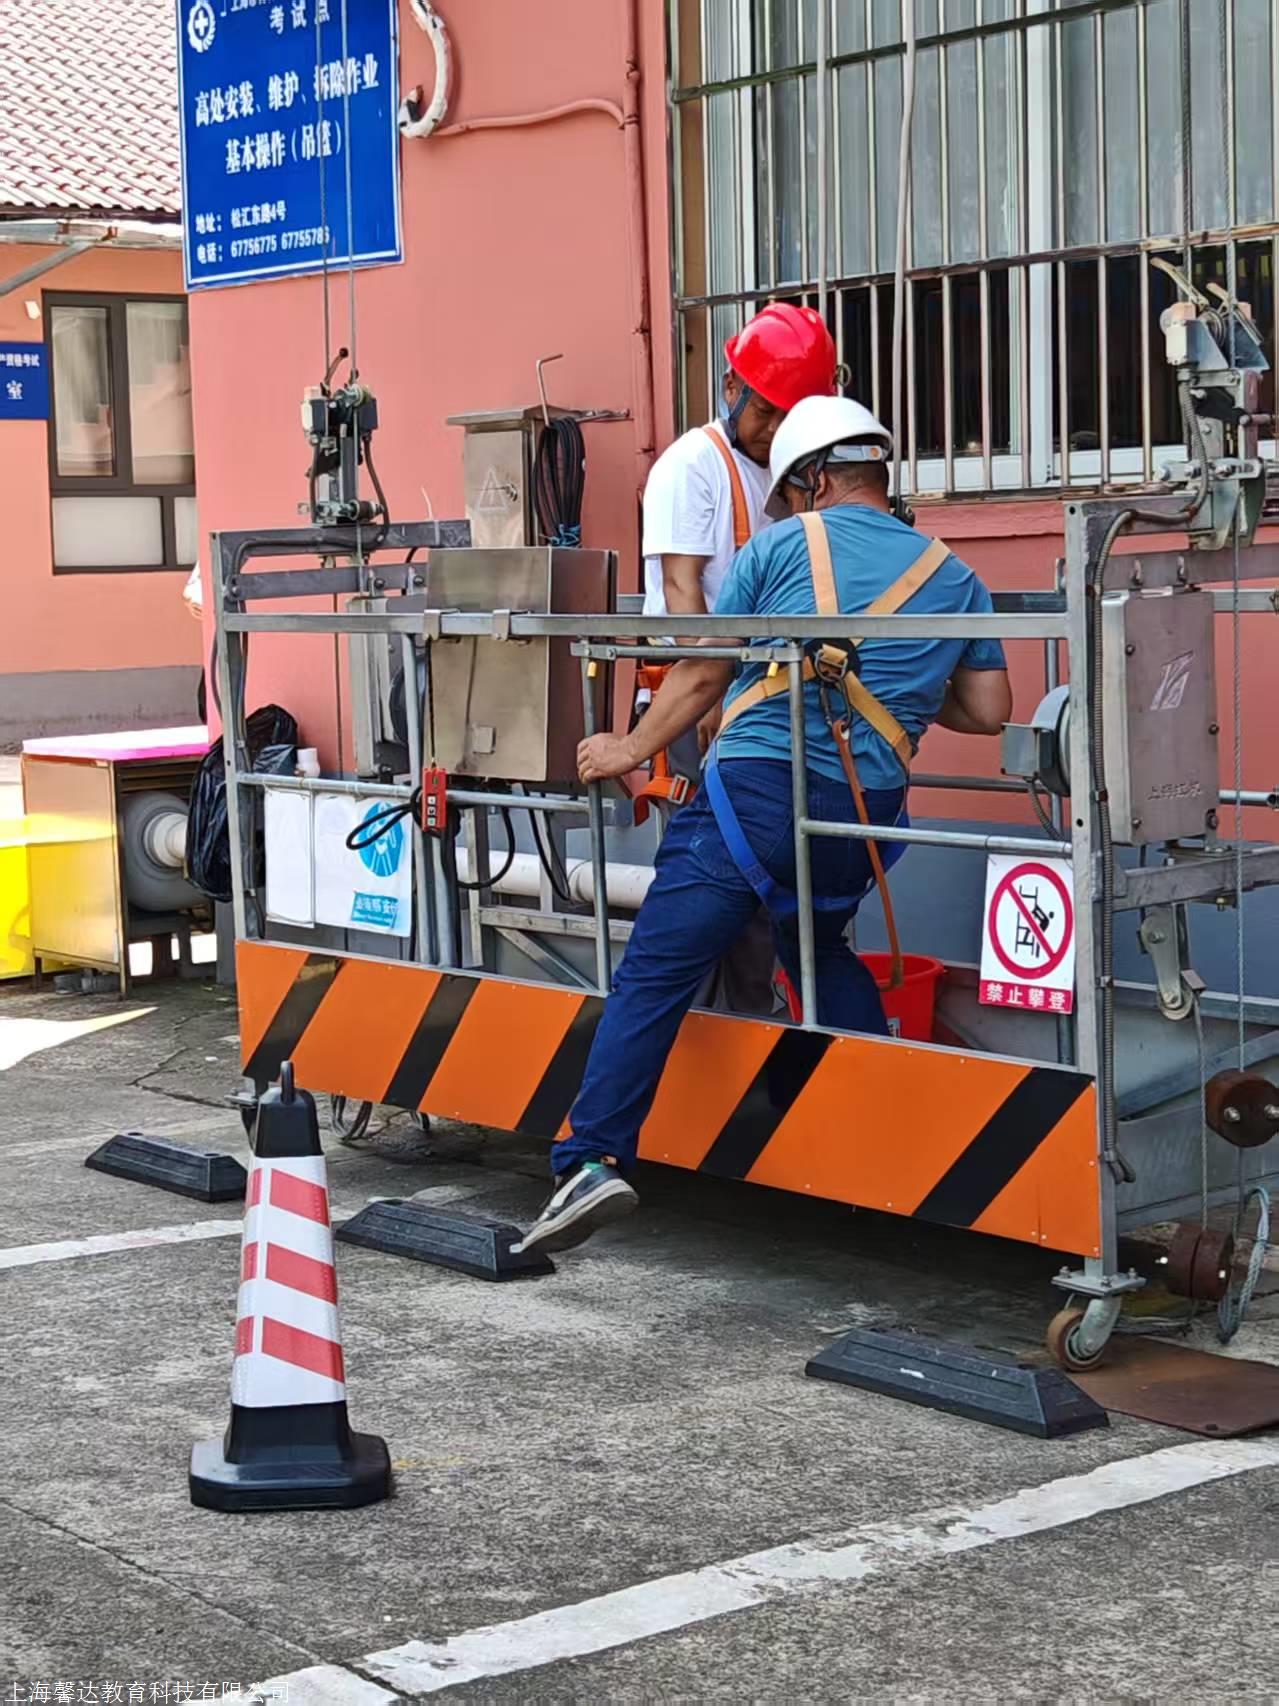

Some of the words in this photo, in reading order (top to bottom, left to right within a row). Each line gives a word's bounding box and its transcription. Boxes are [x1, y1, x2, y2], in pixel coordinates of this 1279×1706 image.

[268, 0, 331, 34] 考试点
[230, 234, 278, 258] 67756775
